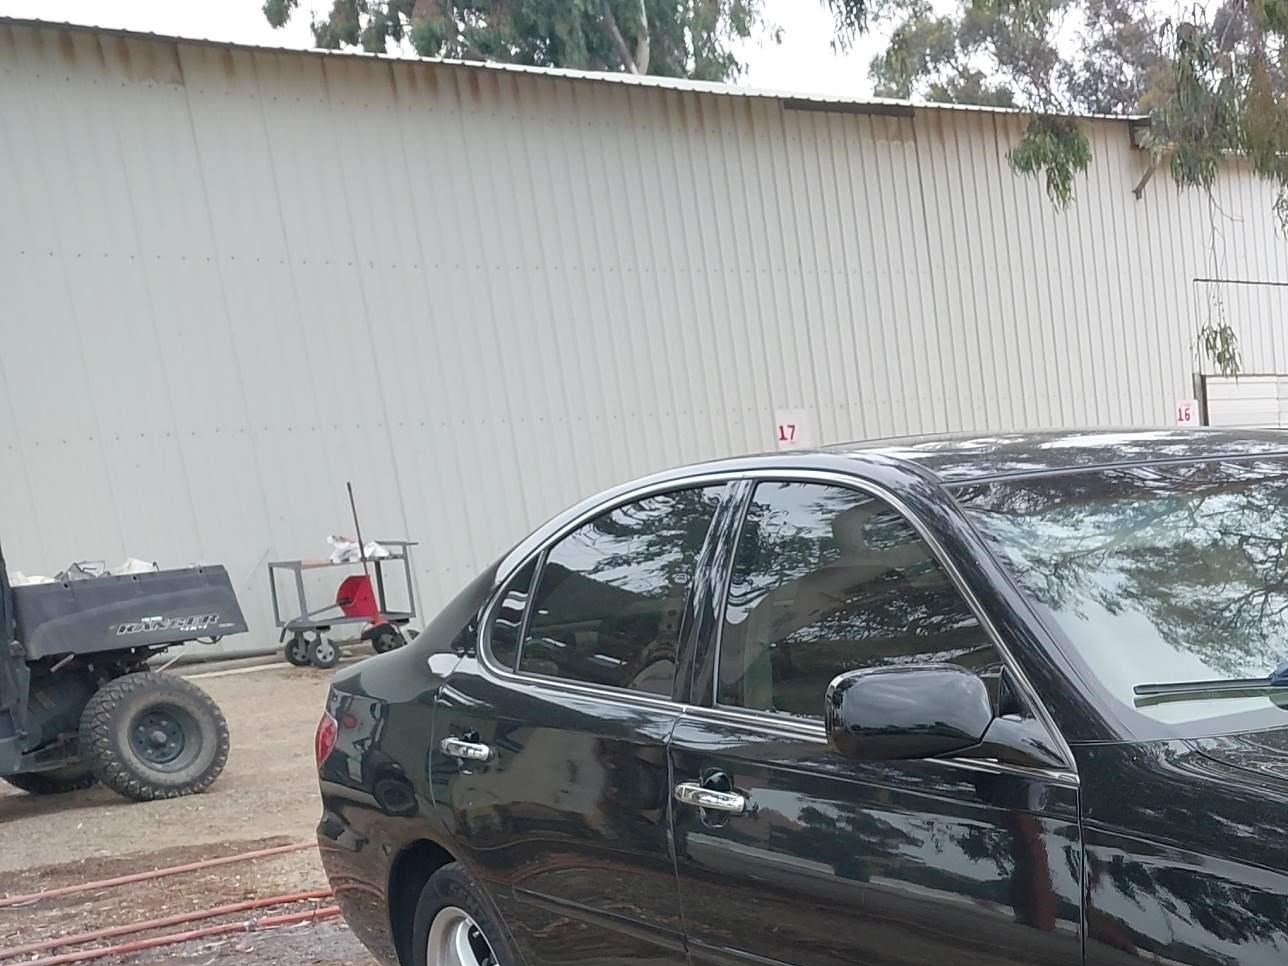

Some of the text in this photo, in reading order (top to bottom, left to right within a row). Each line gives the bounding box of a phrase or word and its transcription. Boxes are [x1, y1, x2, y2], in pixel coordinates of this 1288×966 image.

[1178, 407, 1191, 422] 16
[779, 424, 795, 441] 17
[116, 613, 219, 635] RANGER
